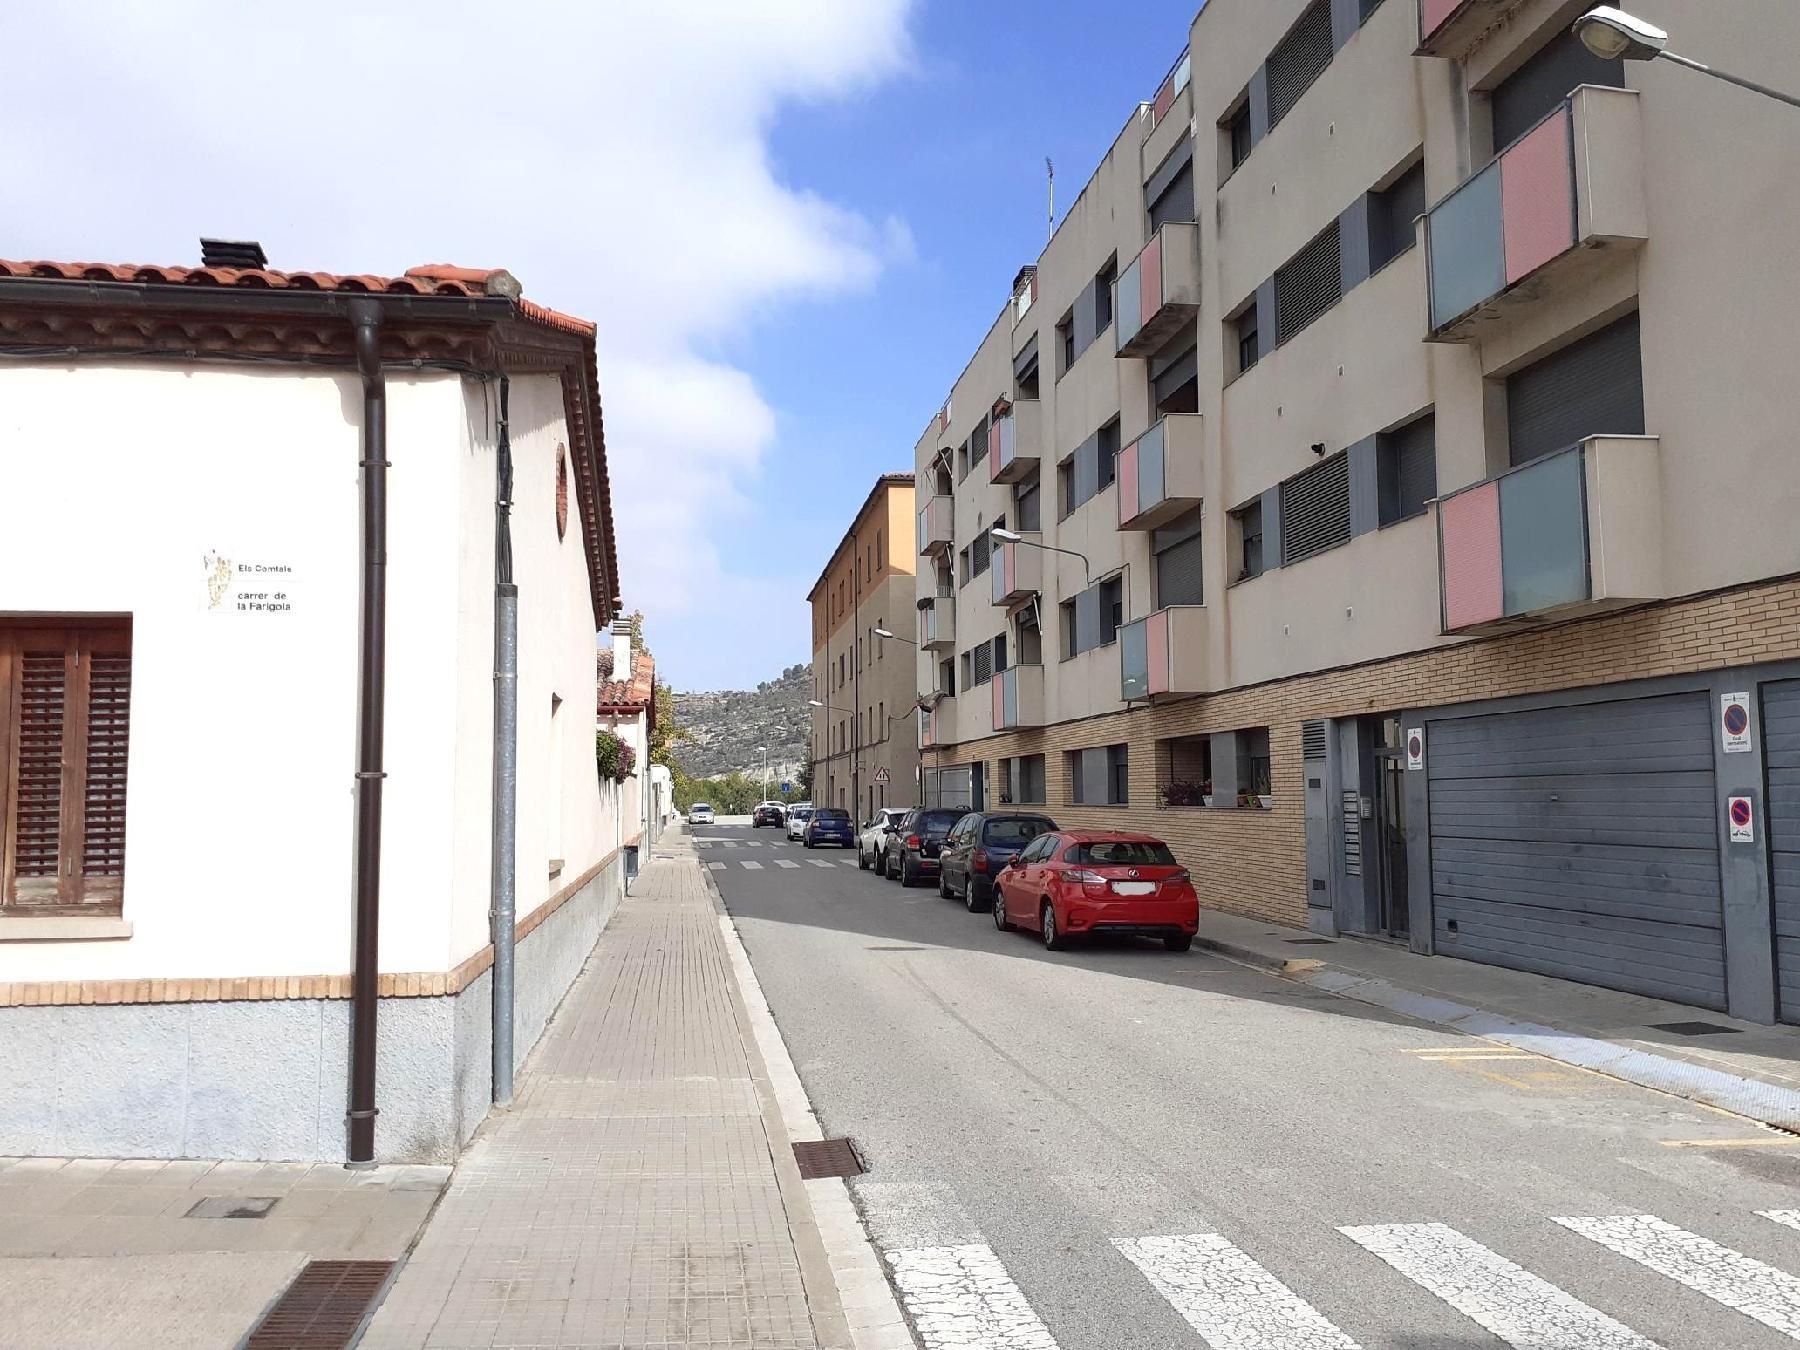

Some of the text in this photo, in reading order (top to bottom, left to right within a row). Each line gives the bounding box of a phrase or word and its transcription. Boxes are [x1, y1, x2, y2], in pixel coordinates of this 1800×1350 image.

[238, 564, 252, 572] Els
[238, 592, 287, 600] carrer de
[237, 602, 291, 612] la Farigola
